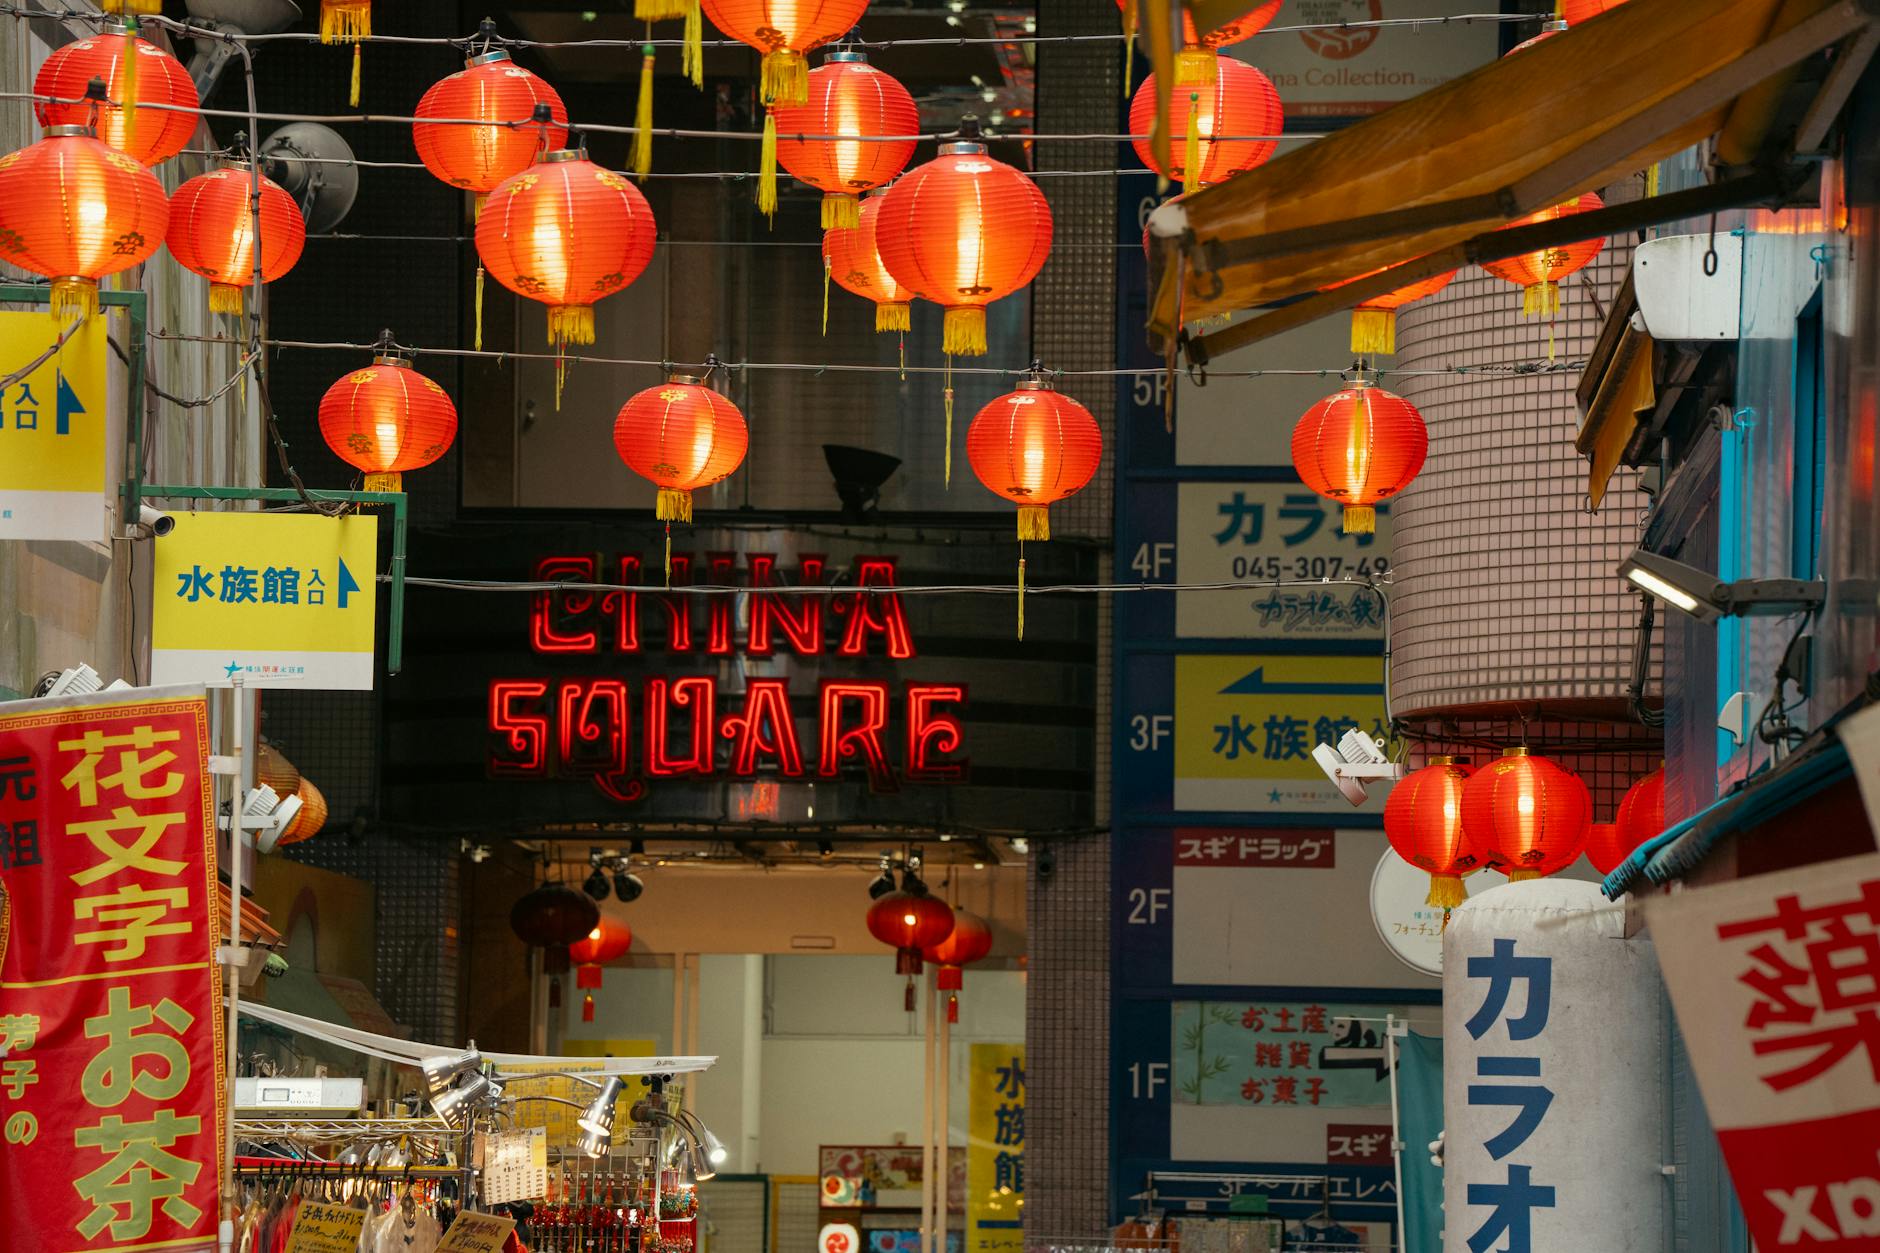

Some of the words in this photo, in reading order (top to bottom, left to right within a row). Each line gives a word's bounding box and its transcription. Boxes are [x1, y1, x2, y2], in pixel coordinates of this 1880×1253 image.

[1305, 68, 1415, 86] Collection
[1131, 543, 1175, 579] 4F
[176, 564, 300, 605] 水族館
[307, 568, 326, 605] 入口
[531, 552, 916, 658] CHINA
[486, 677, 969, 804] SQUARE
[1130, 715, 1173, 751] 3F
[0, 756, 43, 870] 元祖
[58, 726, 192, 962] 花文字
[1128, 888, 1171, 925] 2F
[1240, 1005, 1329, 1035] お土産
[1255, 1042, 1312, 1070] 雑貨
[0, 1014, 39, 1146] 芳子の
[1128, 1062, 1169, 1098] 1F
[1240, 1076, 1329, 1106] お菓子
[74, 986, 202, 1242] お茶
